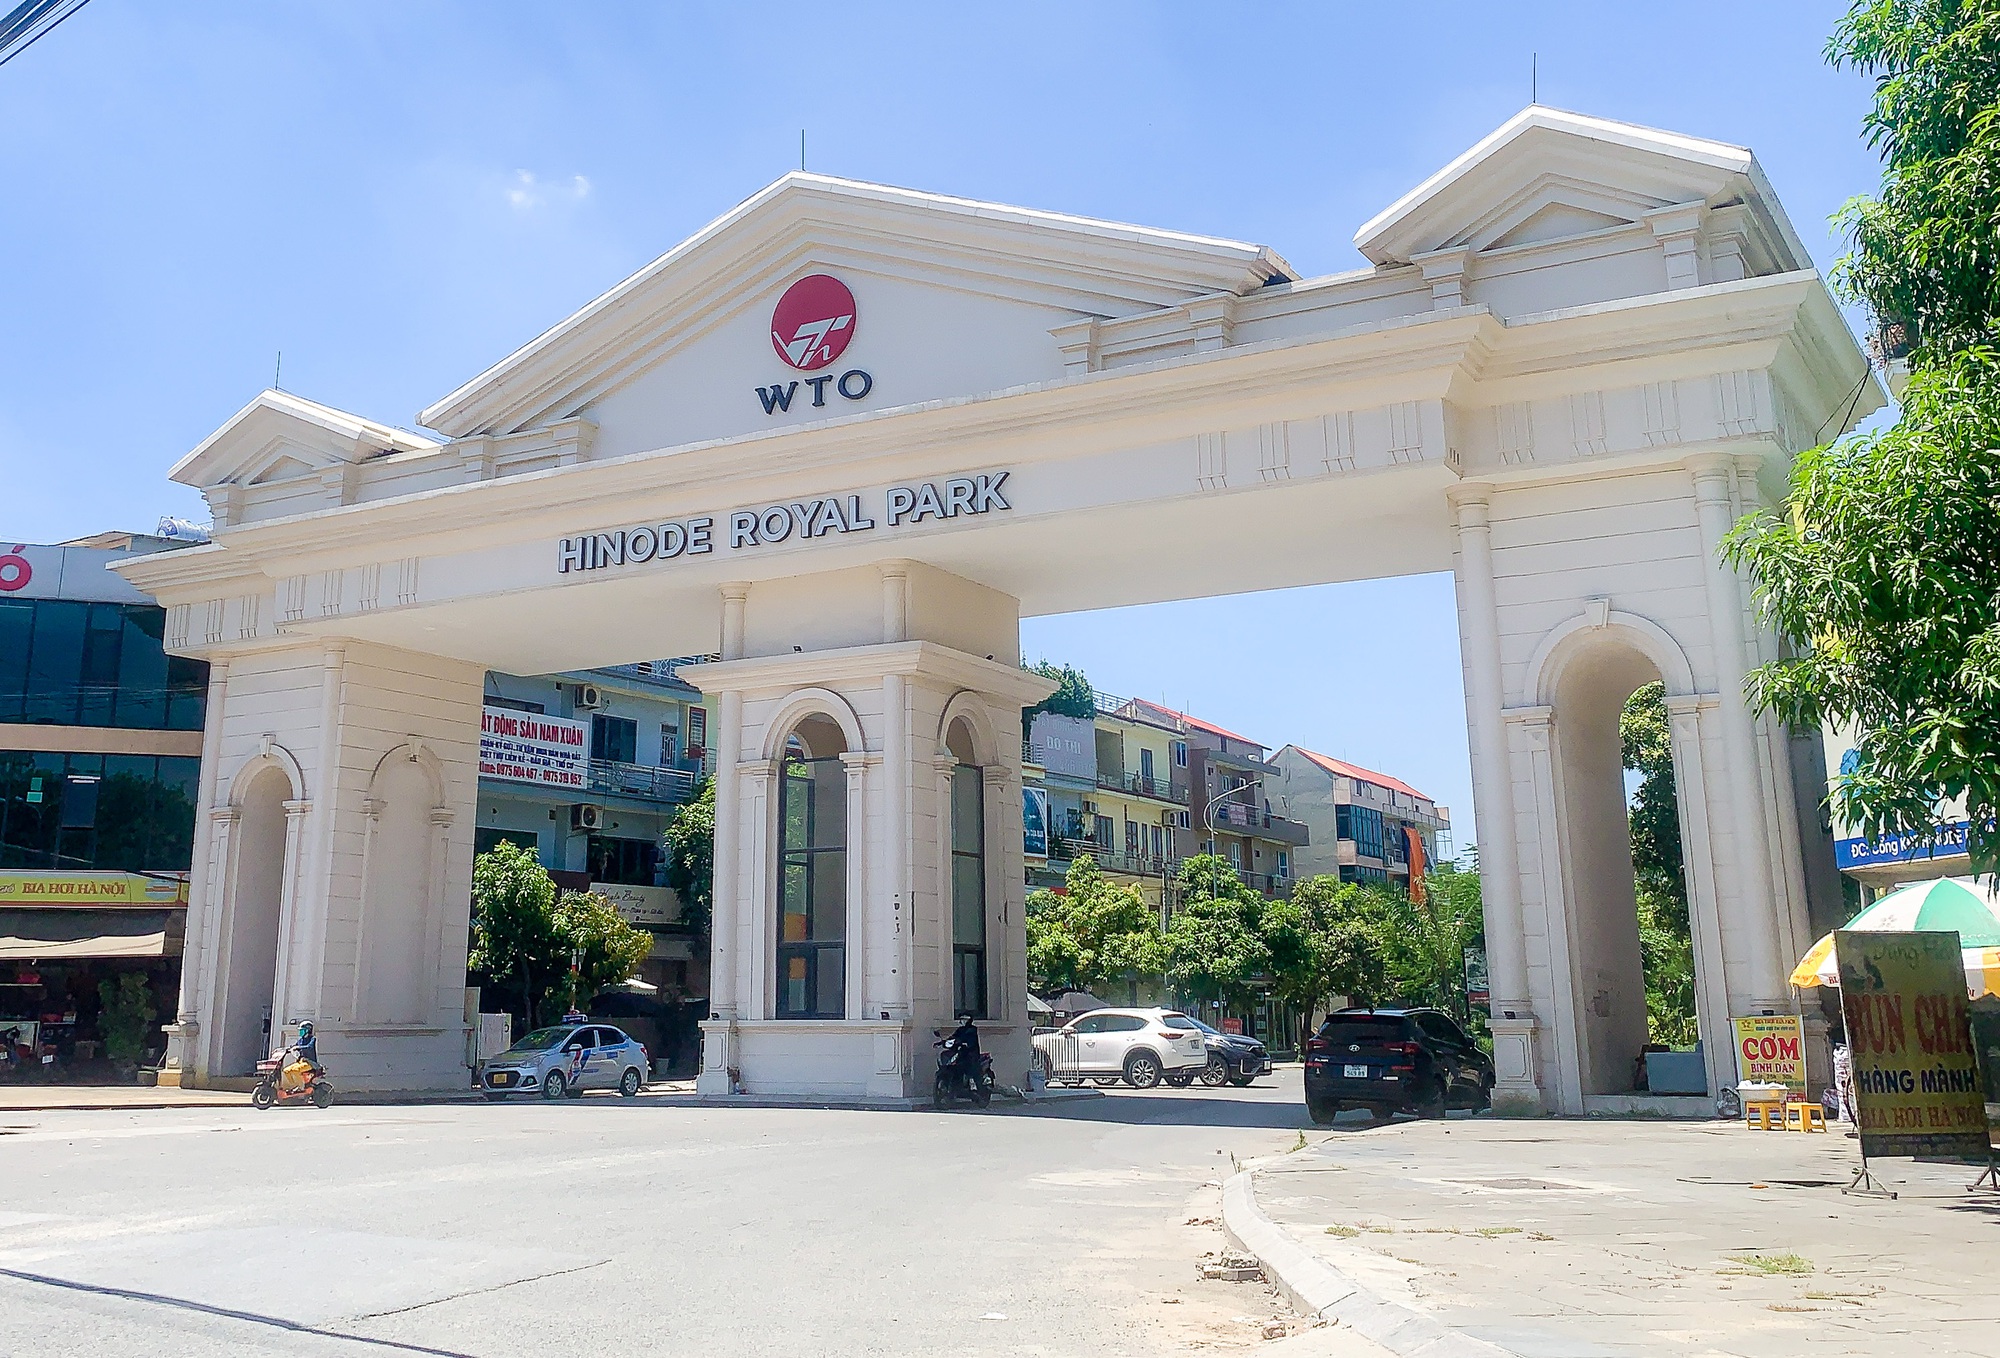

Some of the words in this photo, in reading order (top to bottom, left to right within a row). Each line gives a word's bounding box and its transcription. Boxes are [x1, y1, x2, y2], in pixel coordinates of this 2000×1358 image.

[754, 369, 873, 415] WTO
[558, 516, 713, 574] HINODE
[729, 495, 875, 549] ROYAL
[887, 472, 1010, 526] PARK
[494, 713, 518, 737] ĐỘNG
[520, 715, 538, 739] SẢN
[540, 723, 559, 743] NAM
[560, 725, 583, 746] XUÂN
[1851, 843, 1870, 858] ĐC:
[22, 882, 46, 894] BIA
[77, 880, 98, 894] HÀ
[100, 881, 127, 898] NỘI
[1742, 1033, 1801, 1061] CƠM
[1750, 1060, 1772, 1073] BÌNH
[1775, 1060, 1795, 1073] DÂN
[1859, 1064, 1915, 1093] HÀNG
[1920, 1062, 1976, 1093] MÀNH
